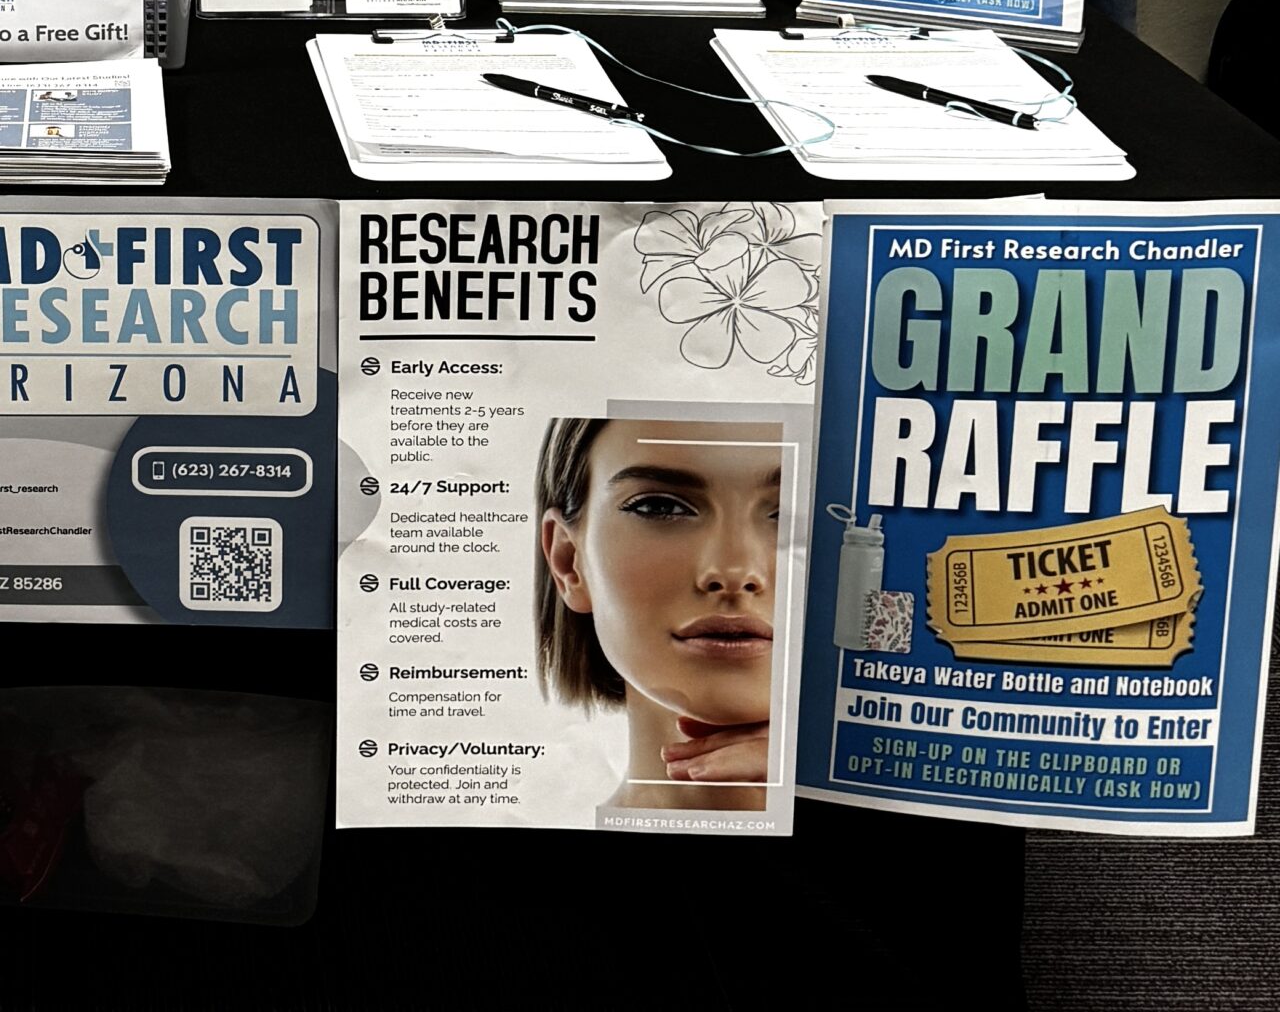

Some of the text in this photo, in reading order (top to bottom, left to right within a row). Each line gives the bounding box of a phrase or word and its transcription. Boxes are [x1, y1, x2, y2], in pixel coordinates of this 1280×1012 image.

[17, 30, 30, 42] a
[36, 25, 79, 41] Free
[85, 23, 128, 41] Gift!
[359, 213, 600, 265] RESEARCH
[117, 227, 302, 286] FIRST
[889, 239, 1243, 260] MD First Research Chandler
[359, 270, 597, 322] BENEFITS
[872, 267, 1245, 394] GRAND
[392, 361, 502, 377] Early Access:
[391, 405, 525, 418] treatments 2-5 years
[868, 397, 1236, 514] RAFFLE
[172, 464, 291, 479] (623) 267-8314
[390, 480, 509, 496] 24/7 Support:
[1007, 539, 1112, 581] TICKET
[13, 577, 62, 590] 85286
[390, 577, 510, 593] Full Coverage:
[1014, 590, 1119, 619] ADMIT ONE
[390, 666, 527, 679] Reimbursement:
[854, 659, 1212, 696] Takeya Water Bottle and Notebook
[389, 742, 544, 758] Privacy/Voluntary:
[604, 817, 774, 830] MDFIRSTRESEARCHAZ.COM
